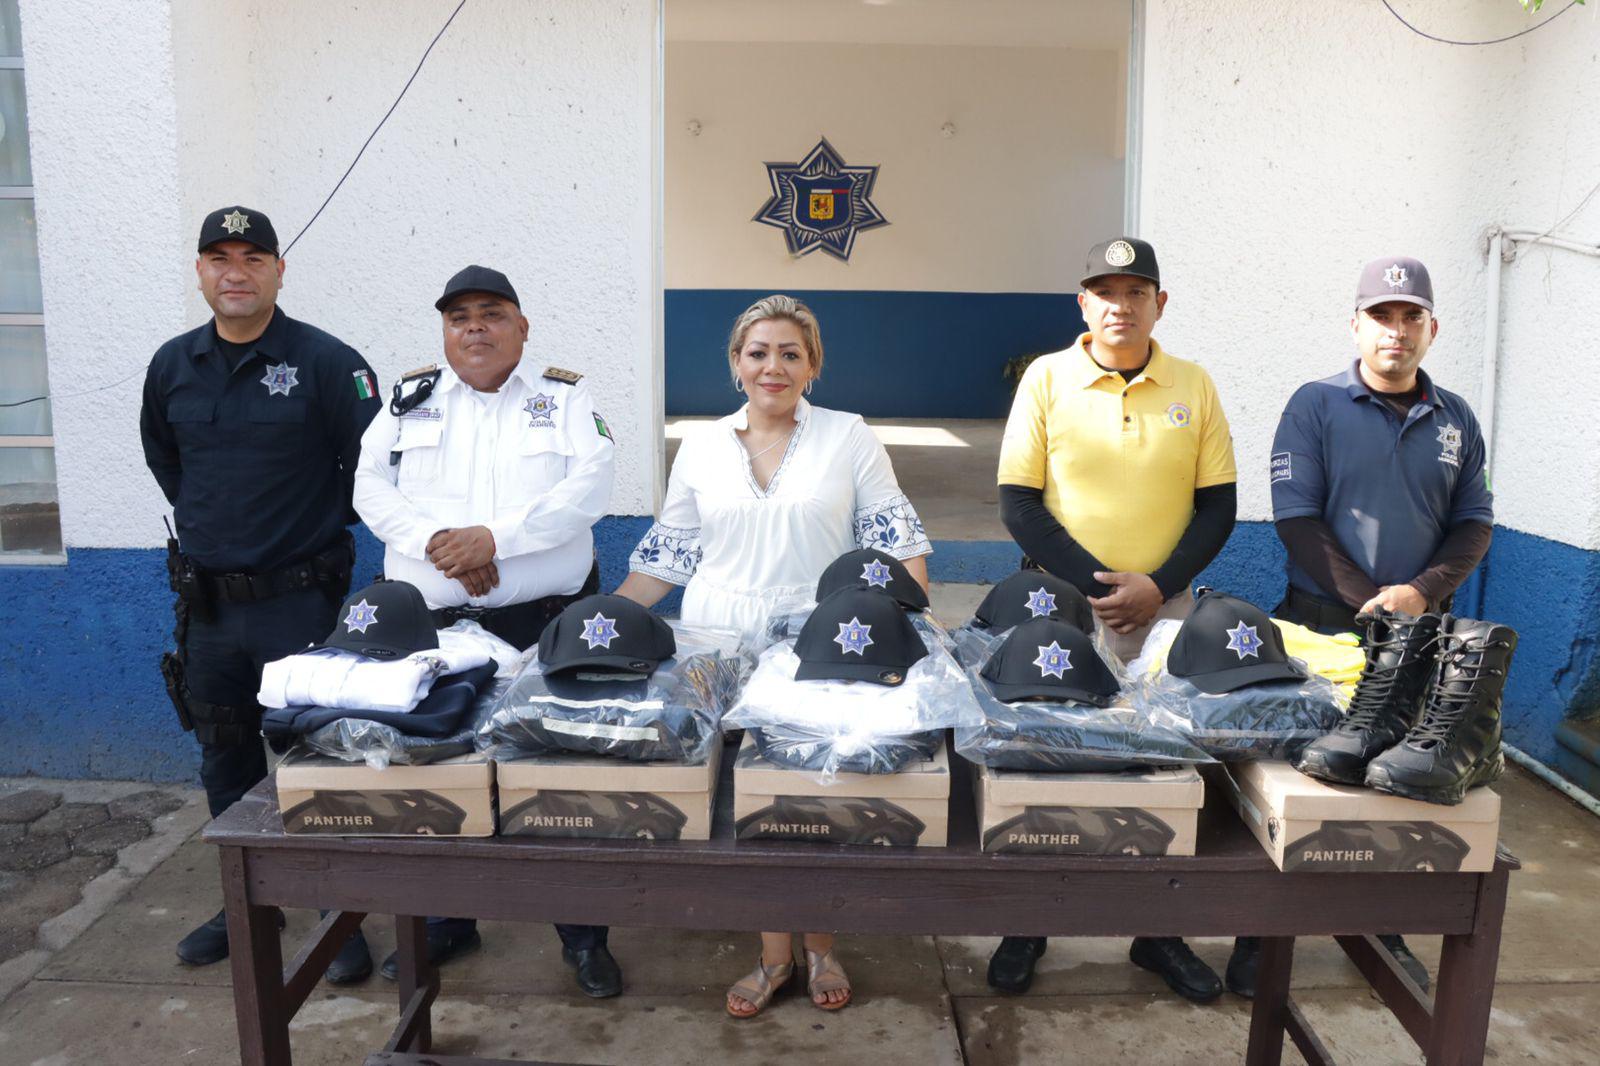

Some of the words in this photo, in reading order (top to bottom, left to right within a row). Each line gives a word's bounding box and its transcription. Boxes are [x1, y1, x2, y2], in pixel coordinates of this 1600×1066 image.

[303, 815, 374, 826] PANTHER
[523, 815, 594, 828] PANTHER
[759, 823, 830, 835] PANTHER
[1008, 833, 1080, 845] PANTHER
[1303, 850, 1374, 861] PANTHER
